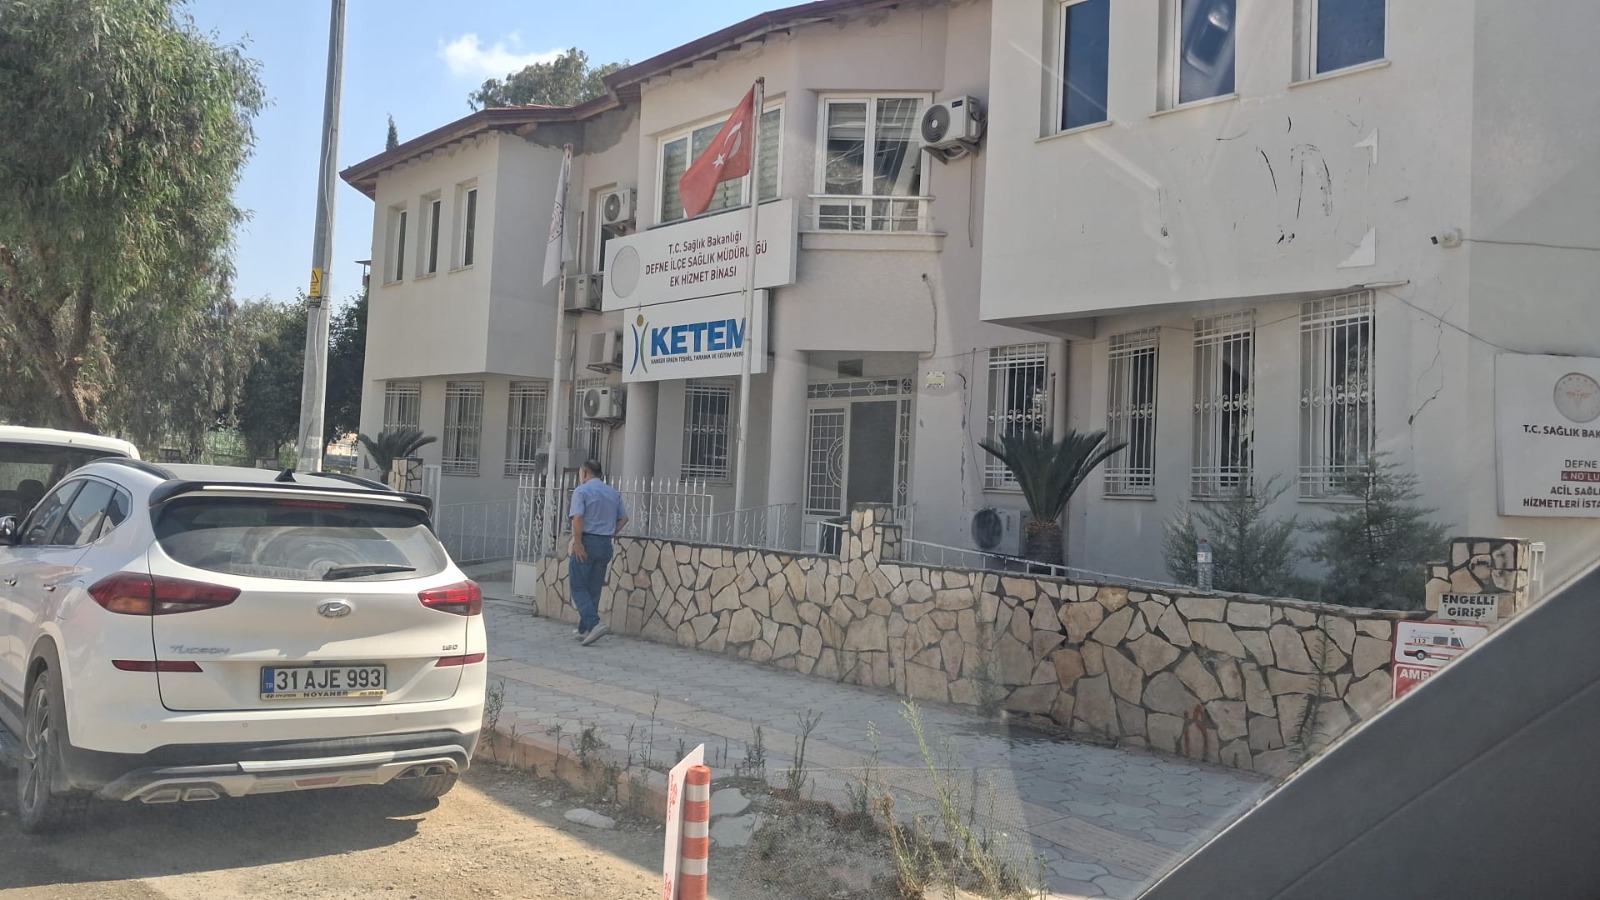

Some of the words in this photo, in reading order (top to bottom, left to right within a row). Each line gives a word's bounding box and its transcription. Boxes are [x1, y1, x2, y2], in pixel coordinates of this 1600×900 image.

[669, 244, 682, 255] T.C.
[683, 238, 705, 252] Sağlık
[707, 231, 742, 247] Bakanlığı
[645, 261, 669, 275] DEFNE
[670, 257, 686, 271] İLÇE
[688, 252, 715, 268] SAĞLIK
[716, 240, 768, 261] MÜDÜRLĞÜ
[669, 275, 680, 287] EK
[681, 270, 709, 285] HİZMET
[710, 265, 737, 280] BİNASI
[651, 317, 746, 356] KETEM
[1523, 425, 1541, 434] T.C.
[1543, 426, 1580, 437] SAĞLIK
[1564, 460, 1598, 468] DEFNE
[1550, 485, 1572, 495] ACİL
[1523, 497, 1579, 508] HİZMETLERİ
[276, 671, 298, 690] 31
[304, 670, 341, 689] AJE
[347, 669, 381, 688] 993
[1400, 669, 1433, 680] AMB
